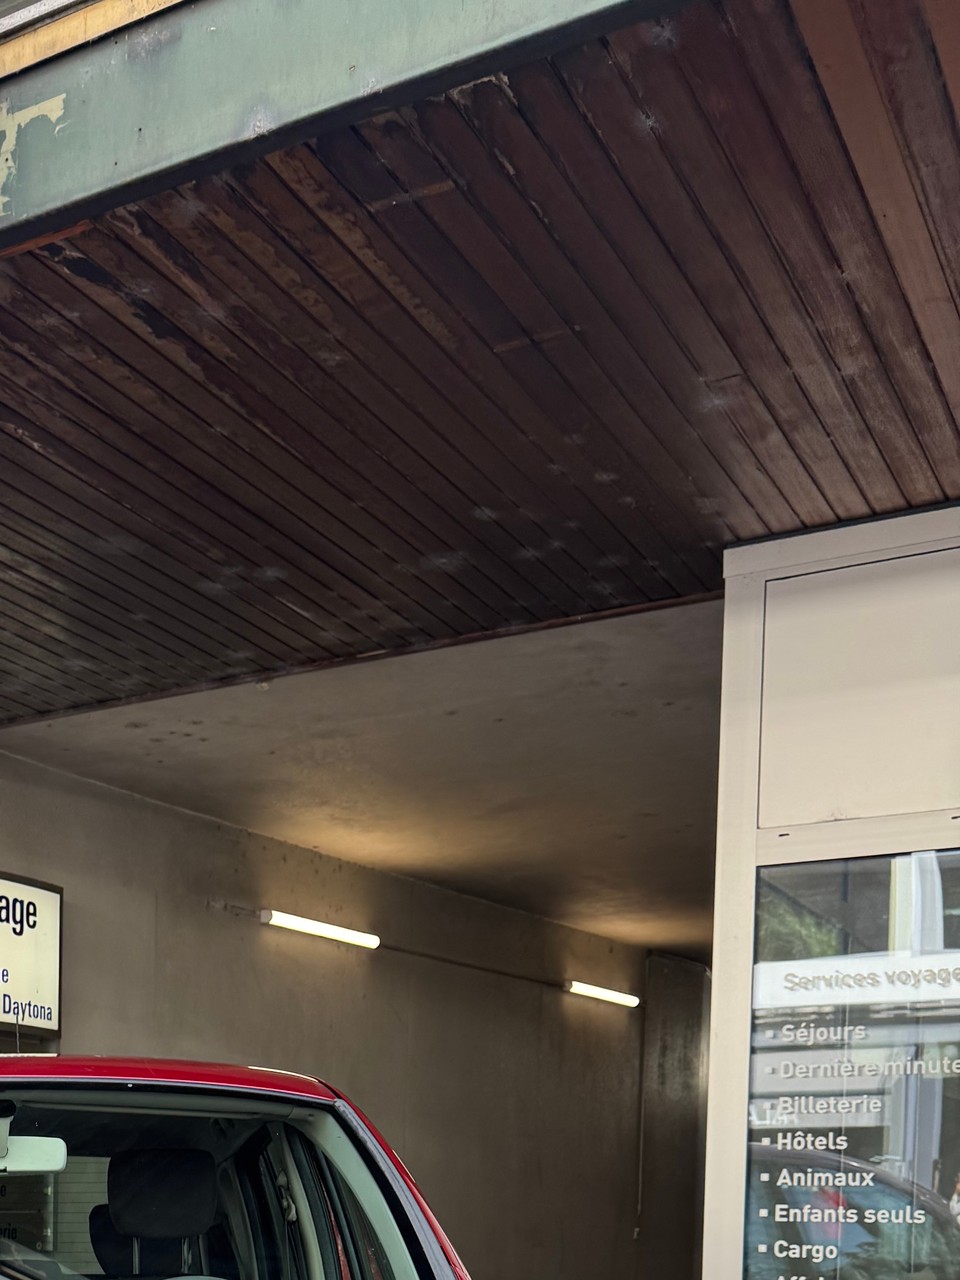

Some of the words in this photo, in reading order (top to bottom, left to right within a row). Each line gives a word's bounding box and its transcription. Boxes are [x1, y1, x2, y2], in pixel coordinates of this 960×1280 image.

[783, 970, 880, 992] Services
[2, 993, 52, 1021] Daytona
[781, 1022, 867, 1045] Séjours
[779, 1058, 883, 1079] Dernière
[776, 1094, 883, 1114] Billeterie
[776, 1131, 849, 1151] Hôtels
[776, 1168, 876, 1187] Animaux
[774, 1204, 859, 1224] Enfants
[864, 1206, 926, 1224] seuls
[773, 1240, 838, 1263] Cargo
